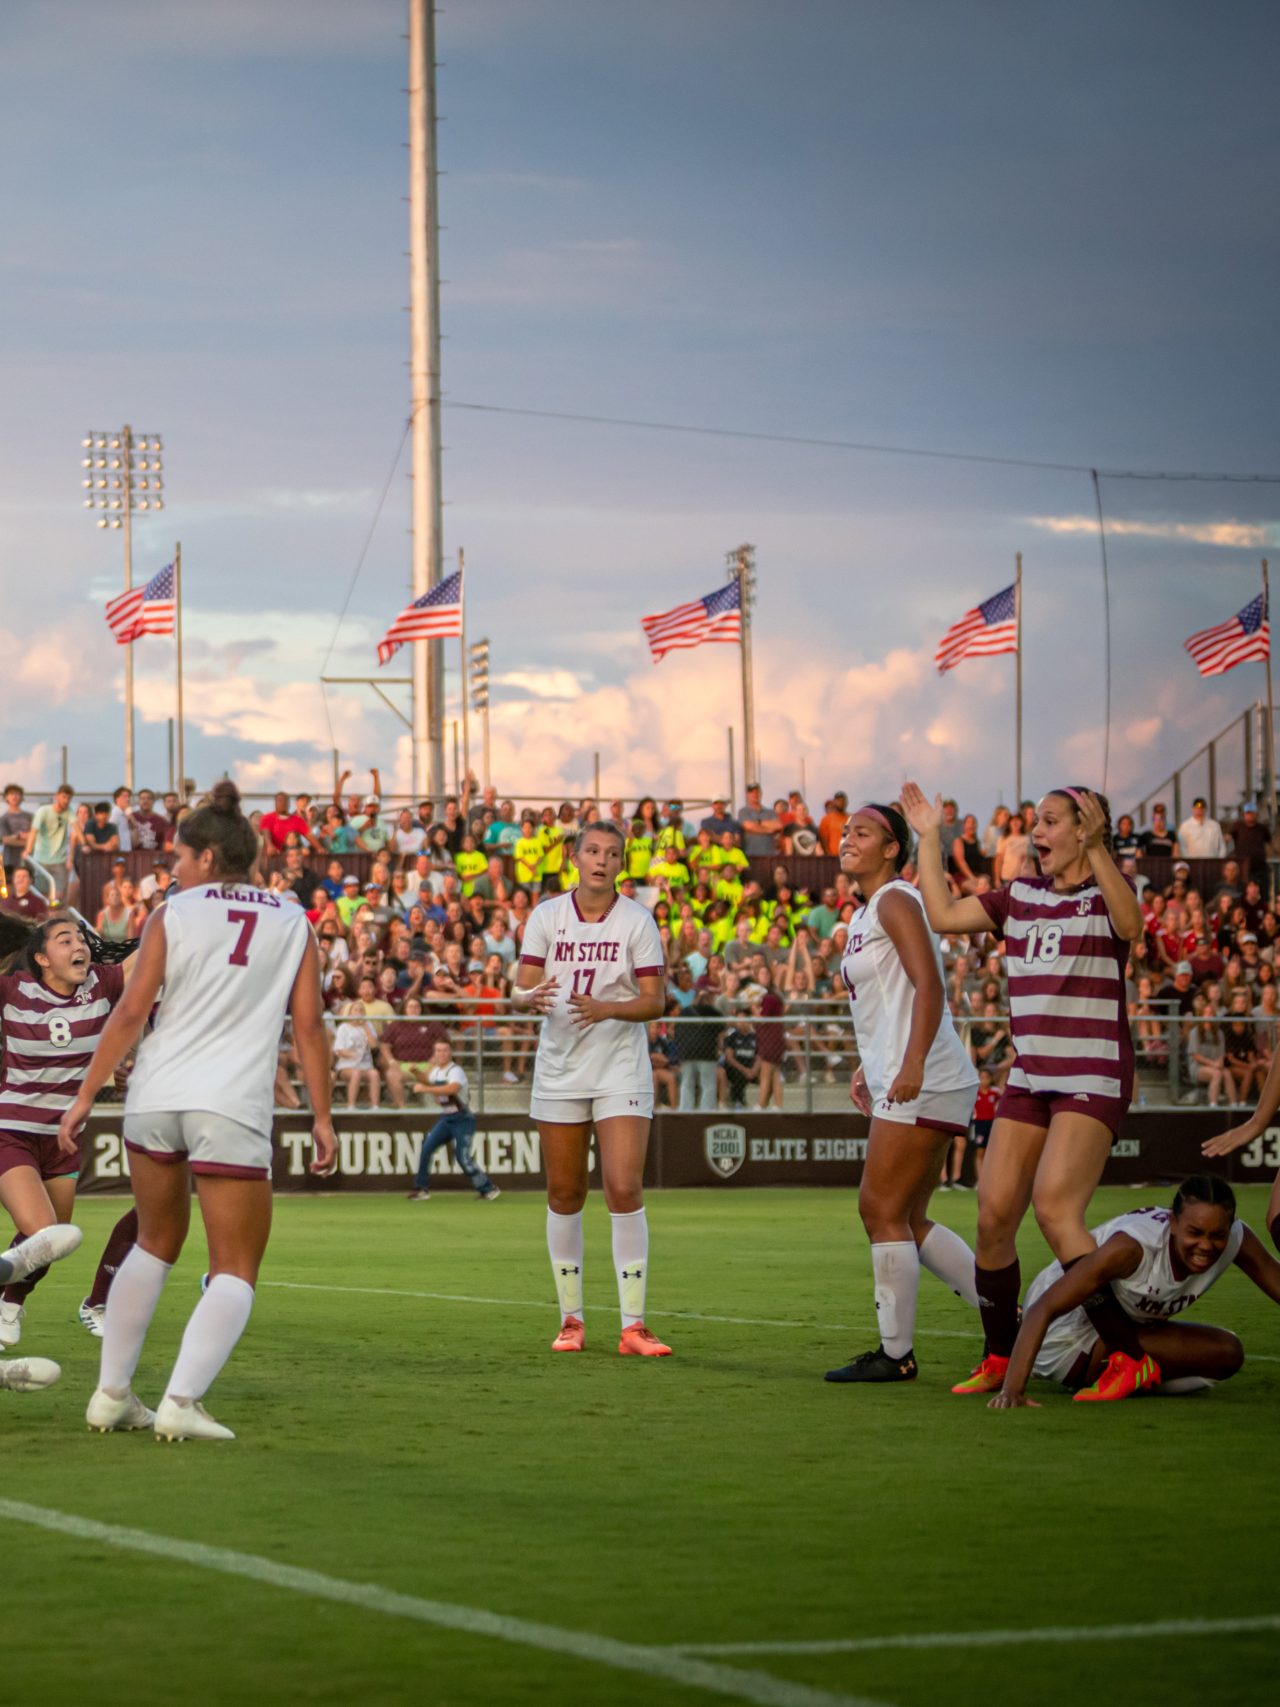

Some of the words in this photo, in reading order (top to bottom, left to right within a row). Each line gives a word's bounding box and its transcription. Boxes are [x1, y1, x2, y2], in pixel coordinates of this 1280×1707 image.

[204, 888, 281, 908] AGGIES
[227, 909, 259, 967] 7
[1024, 924, 1064, 964] 18
[555, 942, 575, 962] NM
[578, 942, 620, 962] STATE
[570, 968, 597, 999] 17
[48, 1016, 73, 1048] 8
[713, 1129, 738, 1140] NCAA
[712, 1142, 740, 1155] 2001
[750, 1139, 807, 1161] ELITE
[813, 1139, 868, 1161] EIGHT
